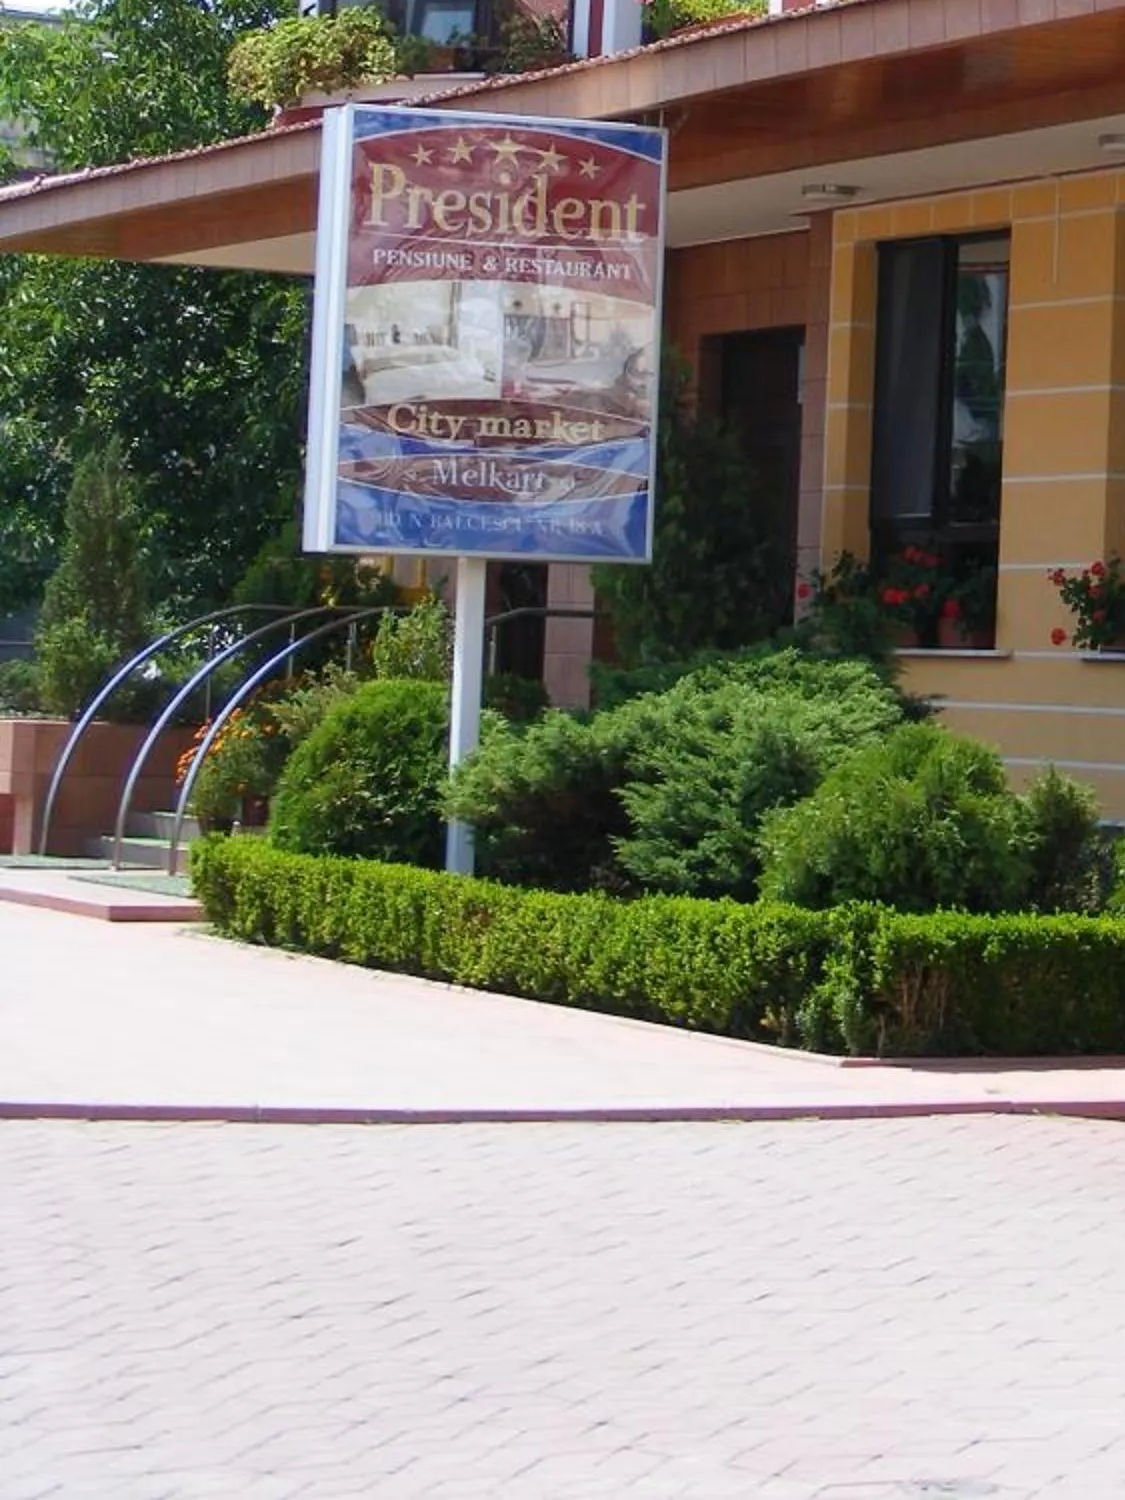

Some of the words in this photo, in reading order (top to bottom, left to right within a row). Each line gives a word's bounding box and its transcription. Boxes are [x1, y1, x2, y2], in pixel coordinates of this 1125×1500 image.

[363, 161, 648, 243] President
[373, 249, 472, 271] PENSIUNE
[483, 258, 498, 271] &
[505, 257, 632, 280] RESTAURANT
[387, 404, 464, 440] City
[476, 411, 605, 444] market
[432, 458, 545, 494] Melkart
